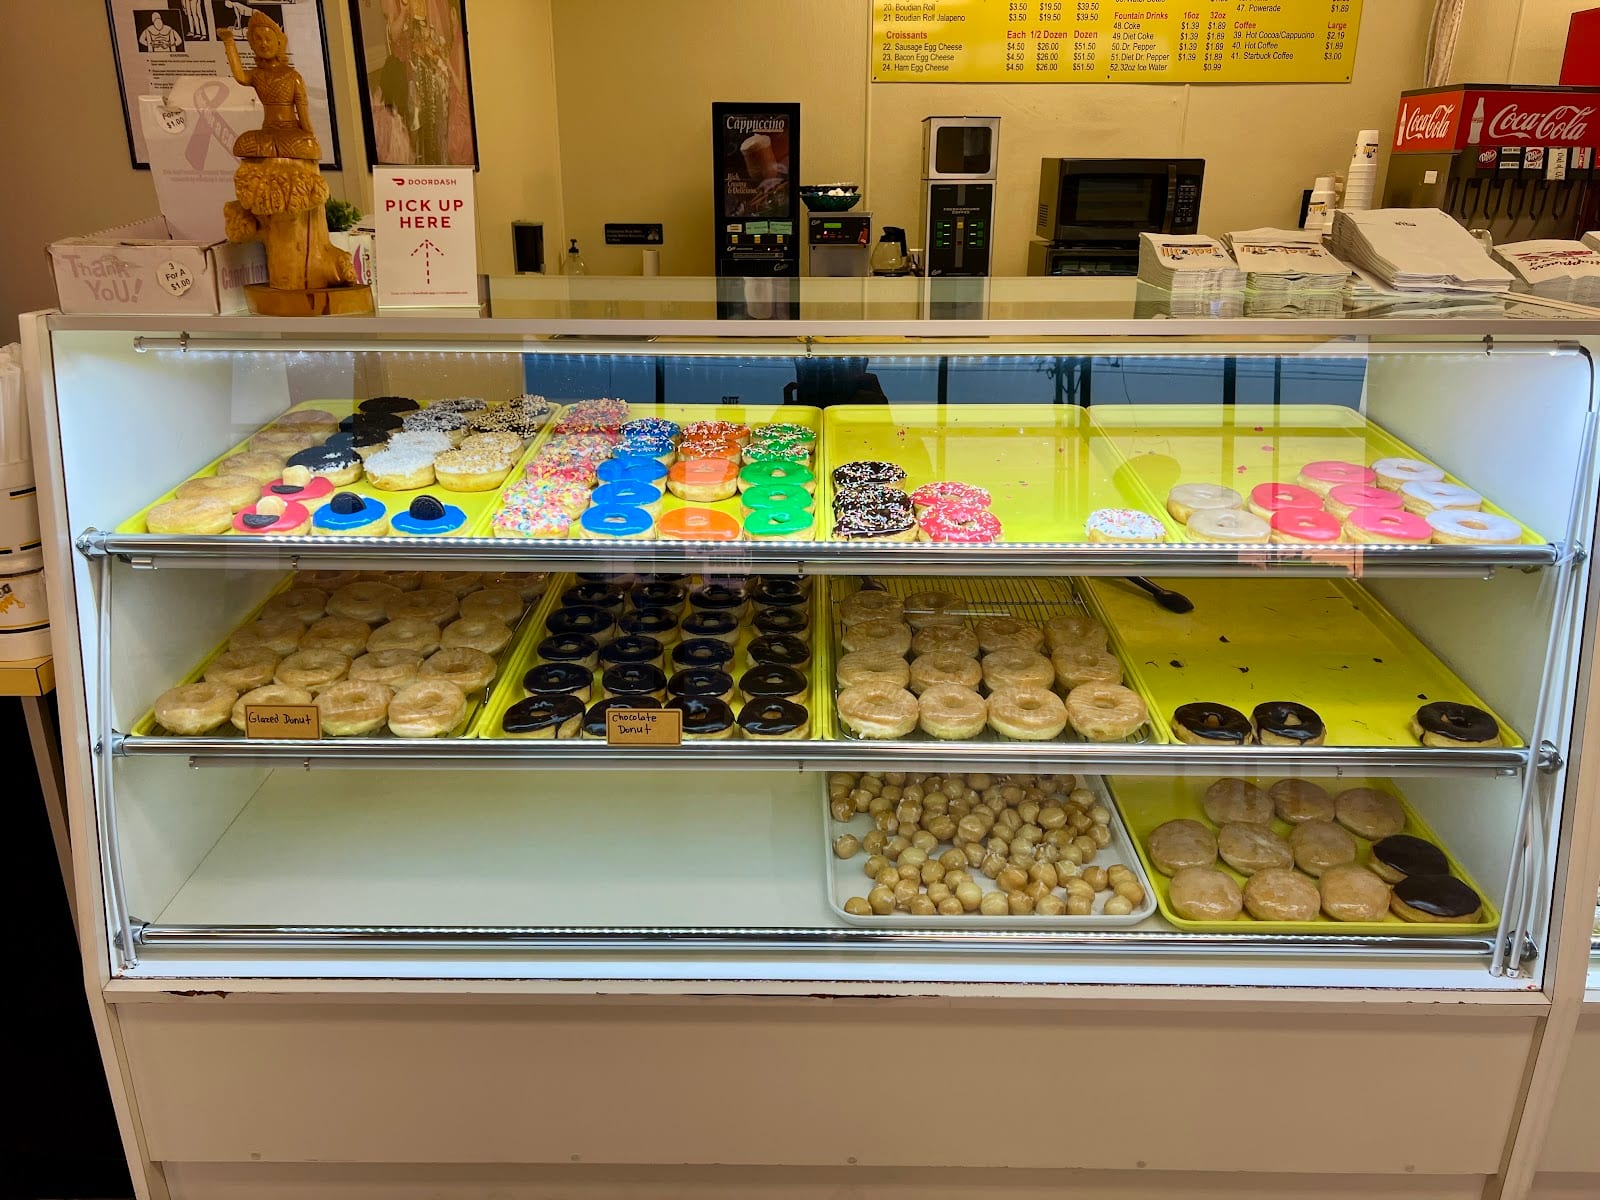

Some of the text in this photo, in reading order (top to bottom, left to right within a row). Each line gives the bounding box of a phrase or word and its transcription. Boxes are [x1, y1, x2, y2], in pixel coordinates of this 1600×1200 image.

[923, 14, 935, 22] Roll
[1114, 12, 1168, 20] Fountain Drinks
[1182, 22, 1200, 30] $1.39
[886, 31, 927, 39] Croissants
[1138, 32, 1154, 40] Coke
[1180, 32, 1198, 40] $1.39
[895, 43, 922, 52] Sausage
[924, 43, 937, 52] Egg
[1133, 43, 1156, 51] Pepper
[1179, 43, 1197, 51] $1.39
[916, 54, 928, 62] Egg
[1007, 53, 1024, 61] $4.50
[1036, 53, 1058, 61] $26.00
[1074, 53, 1095, 61] $51.50
[1146, 53, 1170, 62] Pepper
[911, 64, 923, 72] Egg
[726, 116, 785, 134] Cappuccino
[1406, 103, 1456, 139] Coca-Cola
[1489, 104, 1597, 140] Coca-Cola
[386, 200, 463, 212] PICK UP
[400, 216, 451, 228] HERE
[62, 254, 129, 280] Thank
[165, 272, 179, 281] For
[171, 278, 190, 291] $1.00
[283, 714, 312, 724] Donut
[612, 712, 657, 722] Chocolate
[618, 724, 652, 734] Donut
